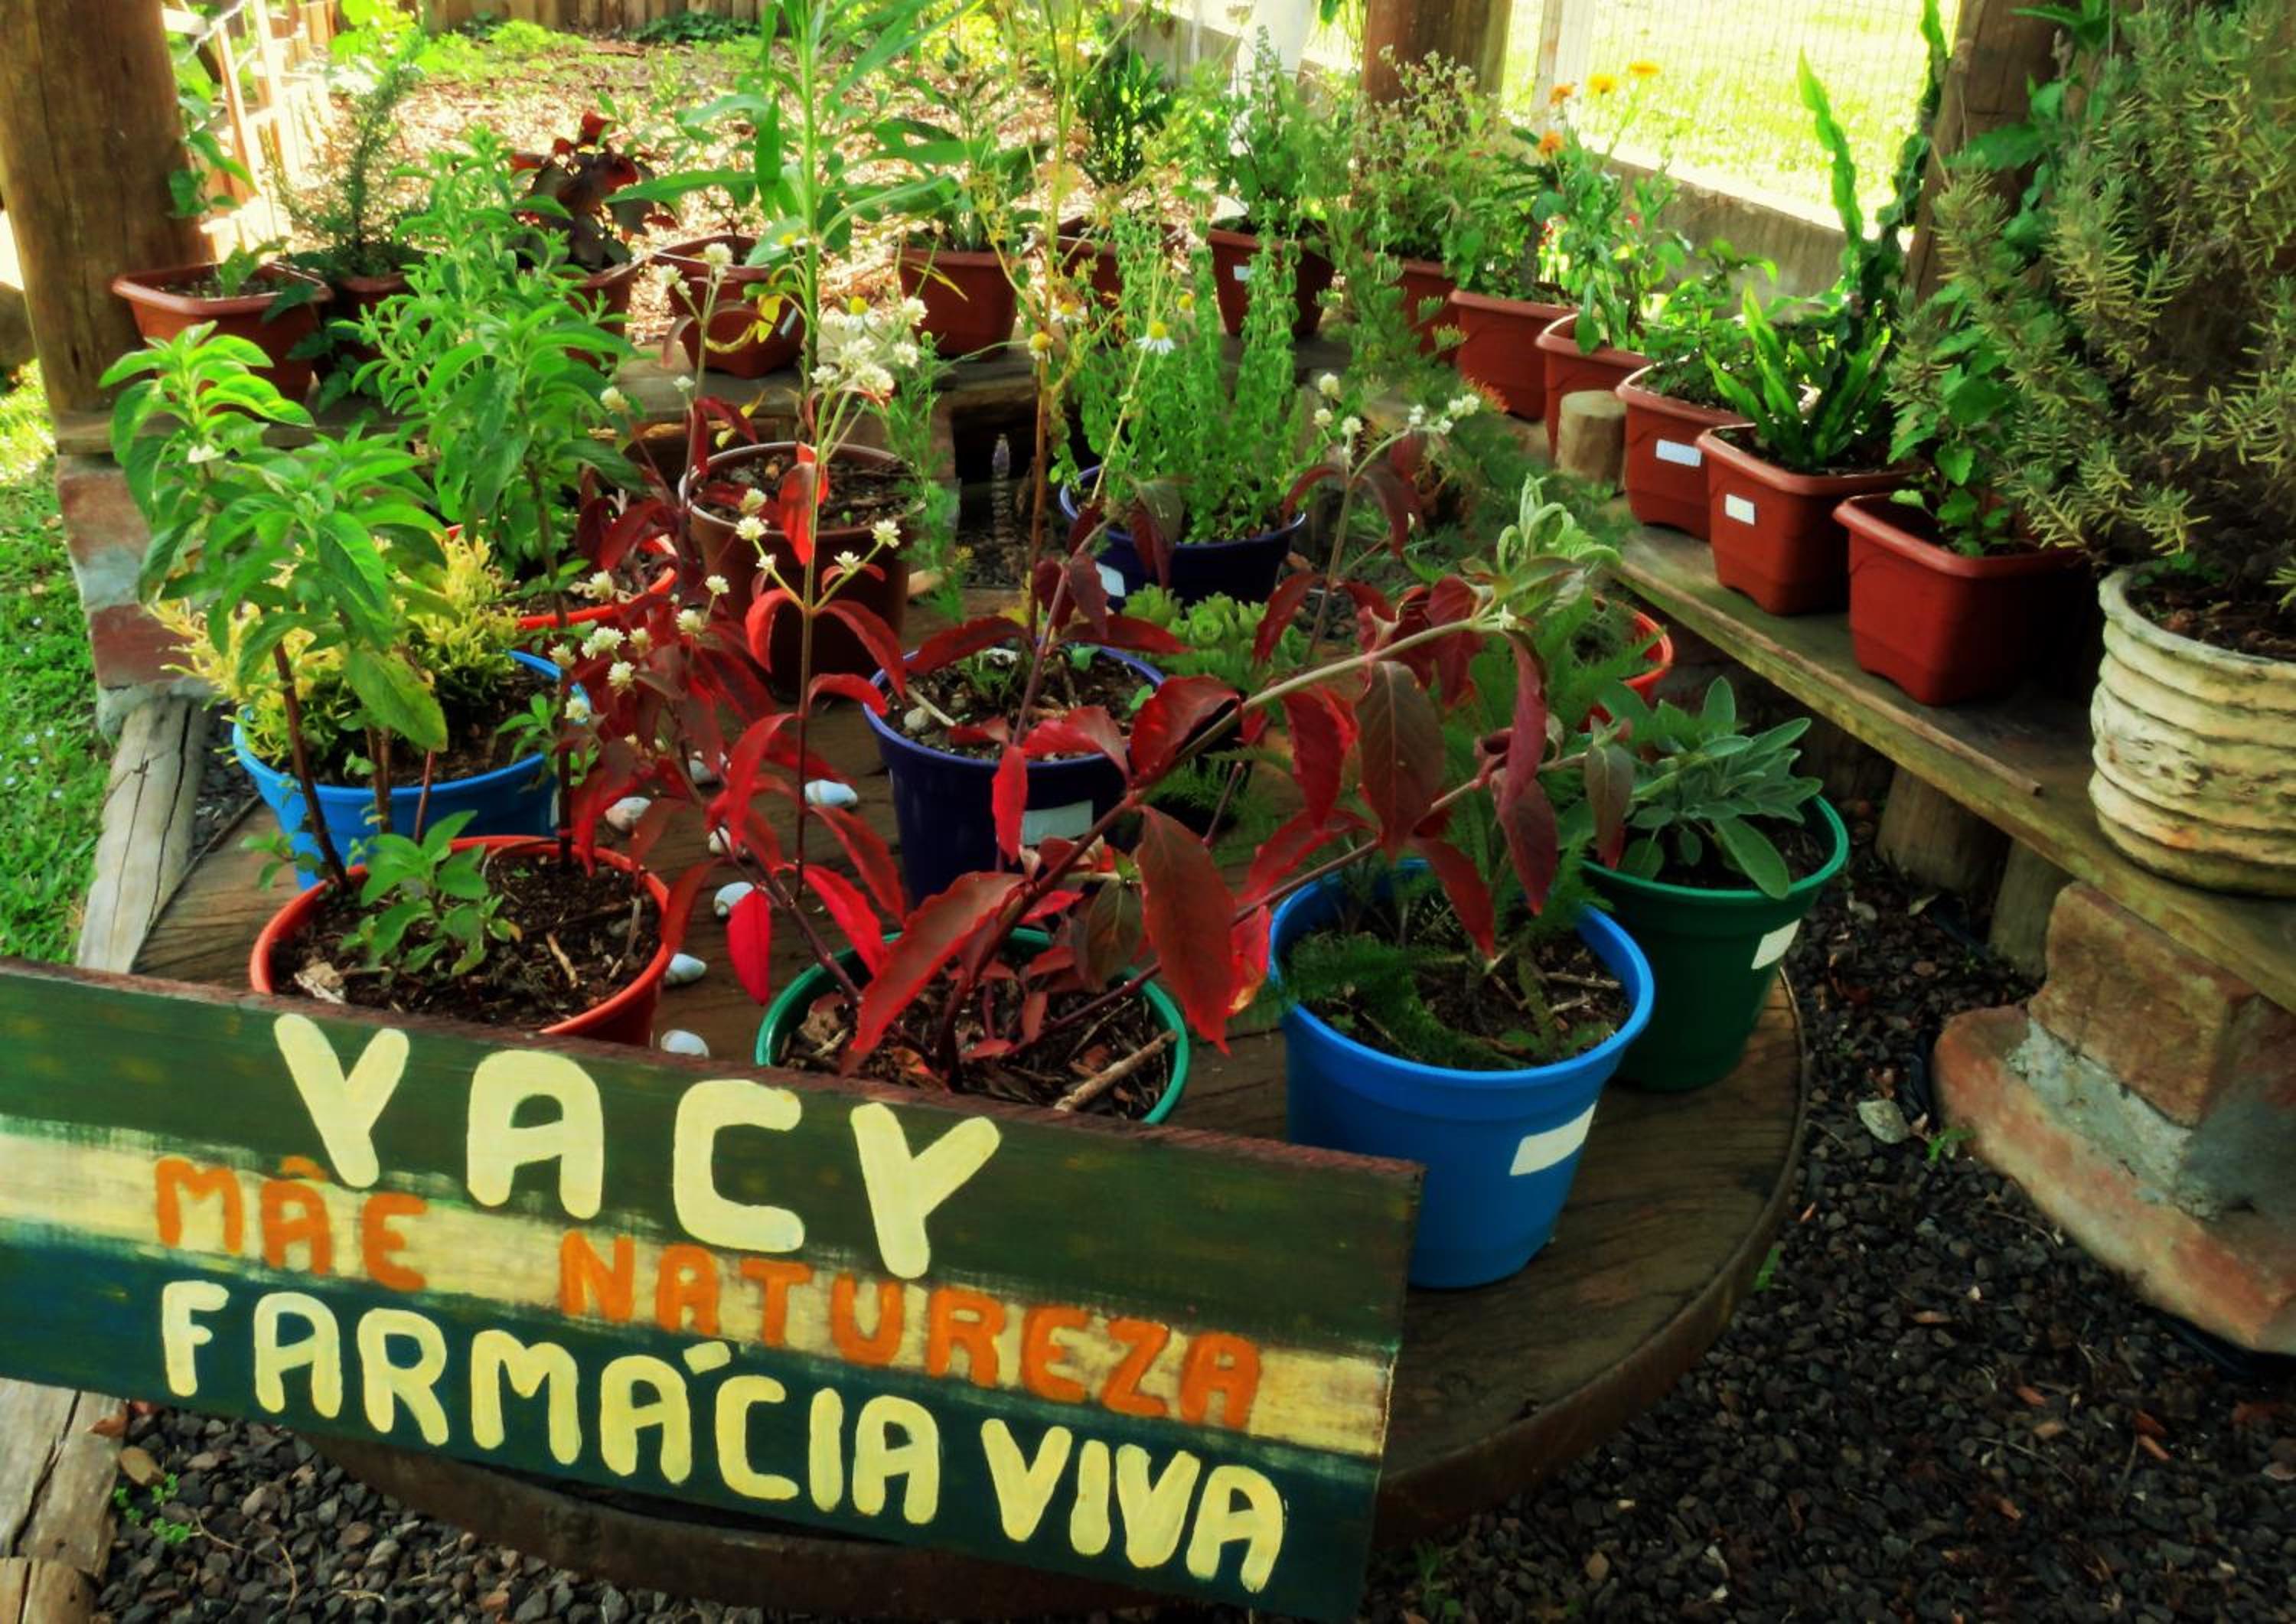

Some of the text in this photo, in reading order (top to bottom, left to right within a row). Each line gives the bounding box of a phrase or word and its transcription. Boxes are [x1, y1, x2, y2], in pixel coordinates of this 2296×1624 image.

[274, 1014, 1001, 1278] YACY
[161, 1280, 1284, 1592] FARMÁCIA VIVA
[559, 1231, 1261, 1430] NATUREZA
